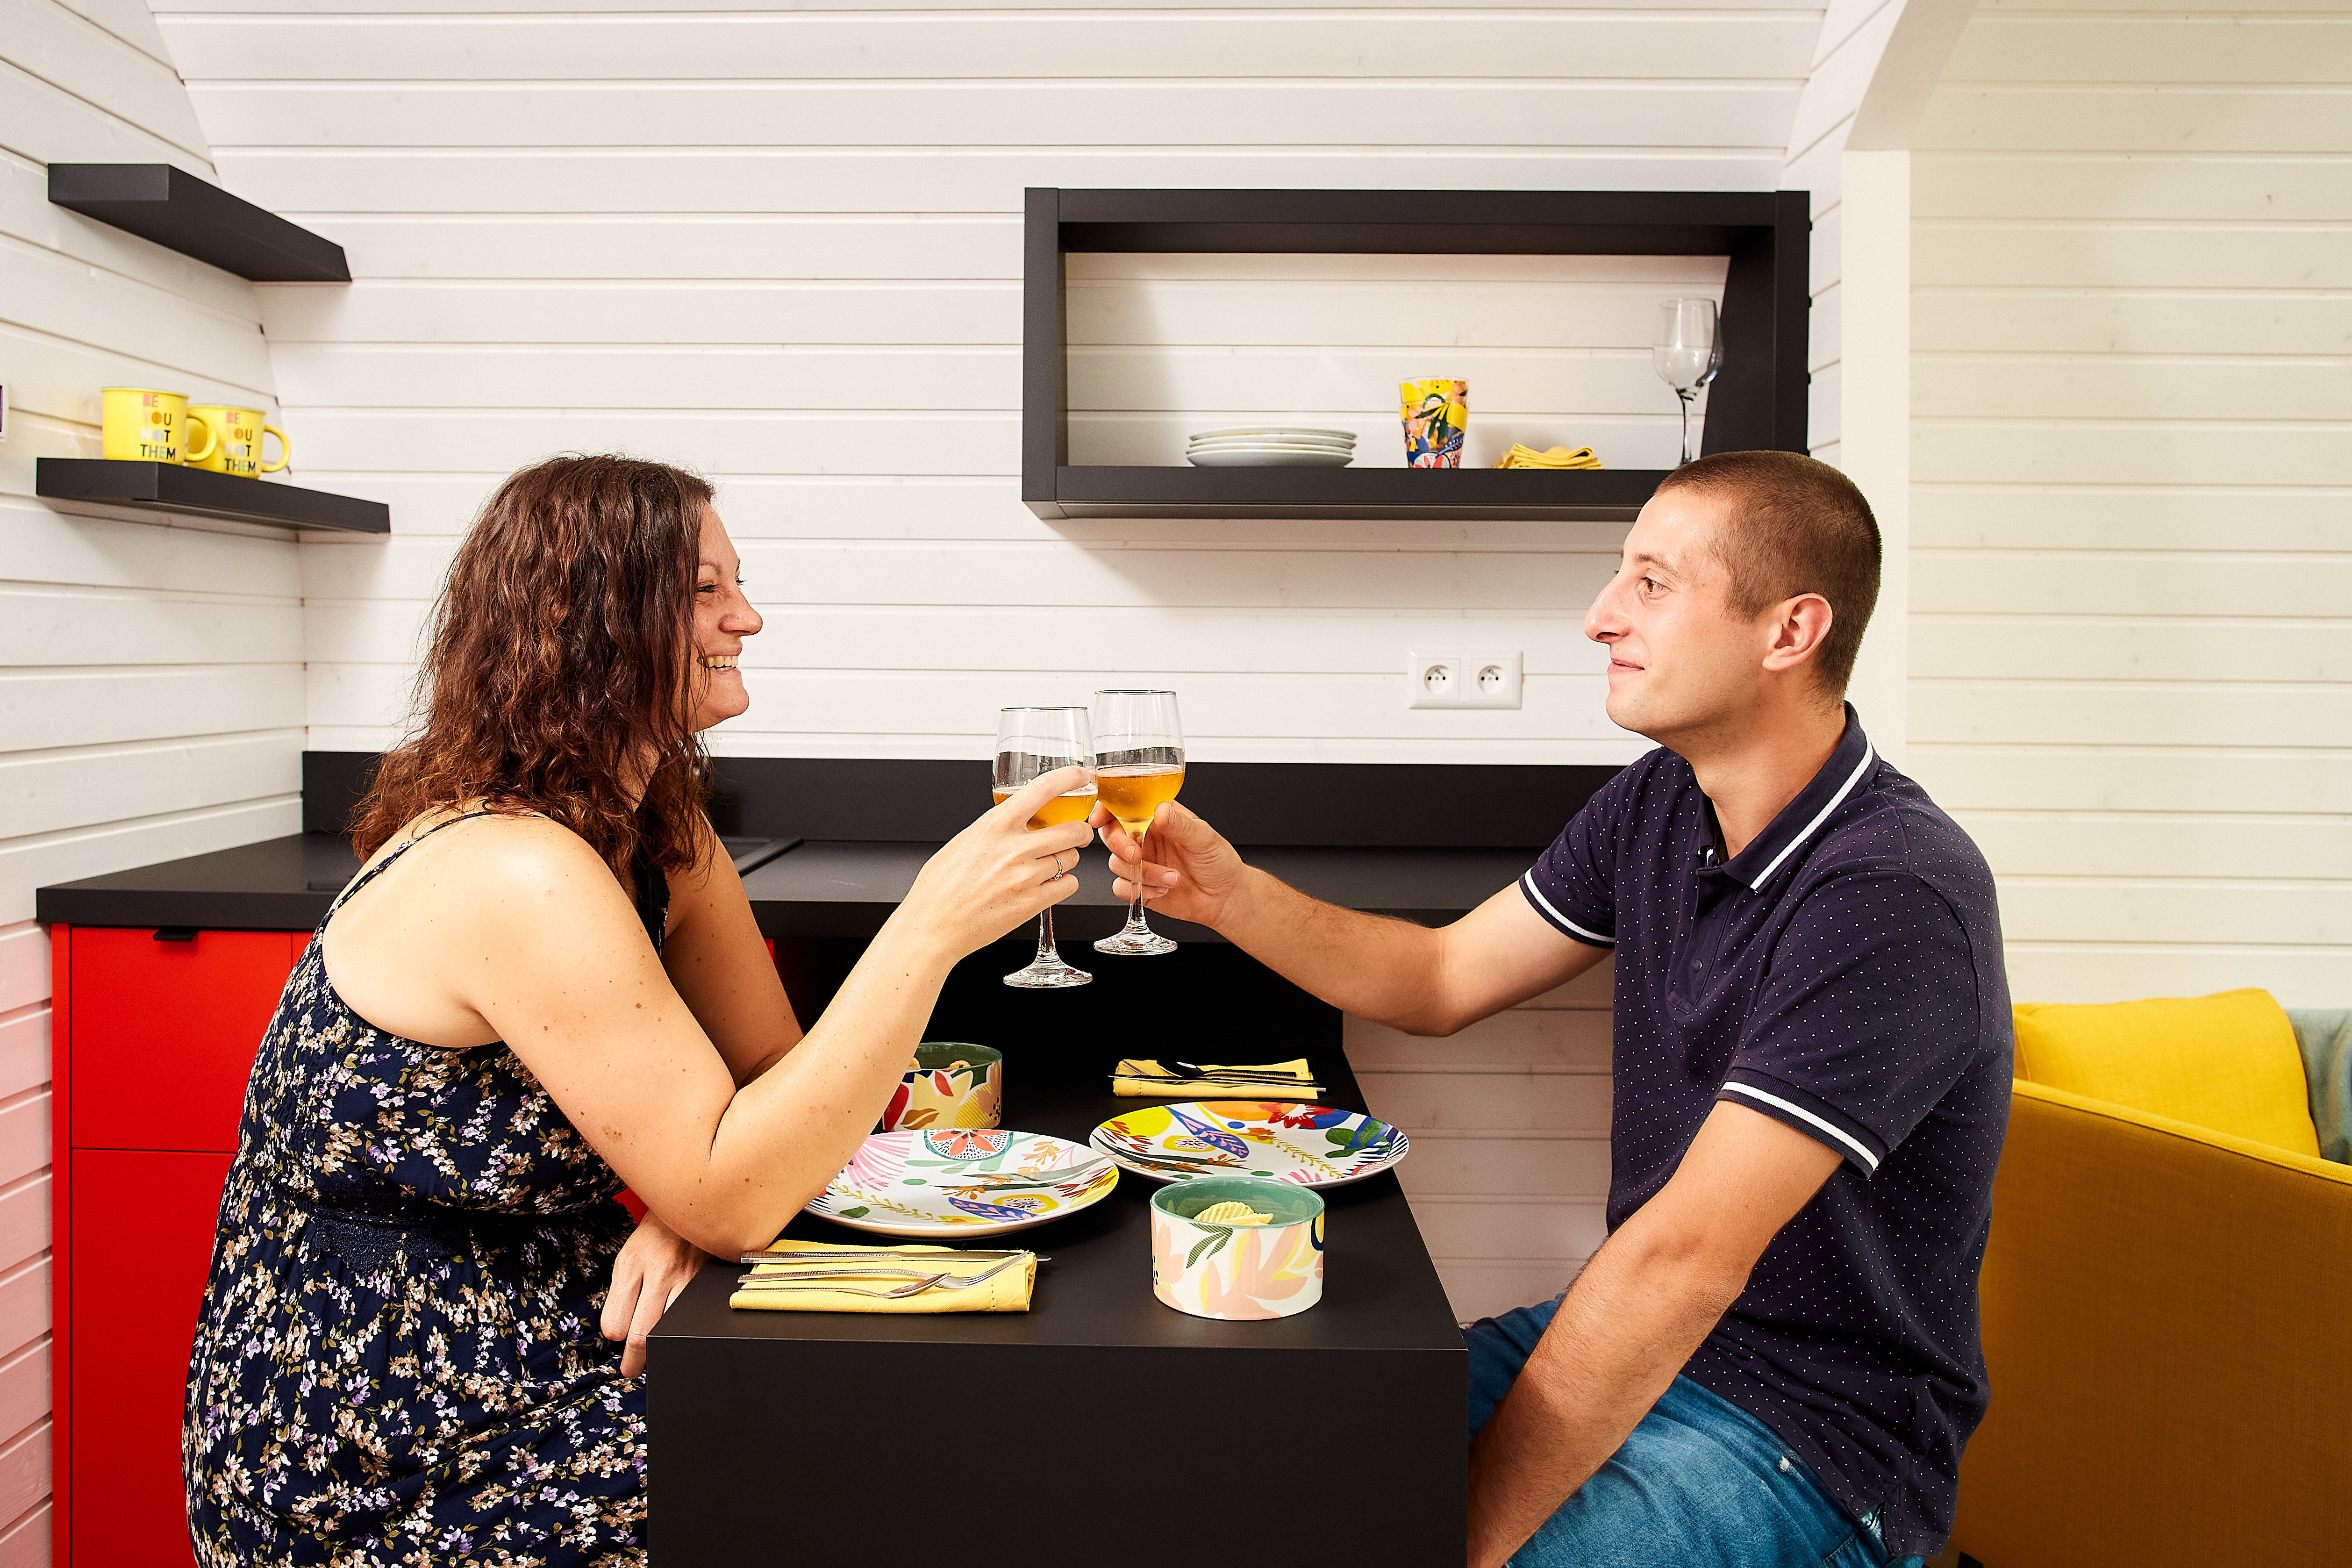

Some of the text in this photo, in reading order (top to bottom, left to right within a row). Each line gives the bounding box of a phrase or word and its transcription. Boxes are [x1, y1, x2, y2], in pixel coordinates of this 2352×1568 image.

[143, 393, 158, 408] BE
[142, 410, 172, 426] YOU
[226, 412, 240, 424] BE
[140, 426, 171, 443] NOT
[227, 428, 252, 441] YOU
[140, 444, 176, 460] THEM
[224, 442, 251, 457] NOT
[225, 458, 256, 473] THEM
